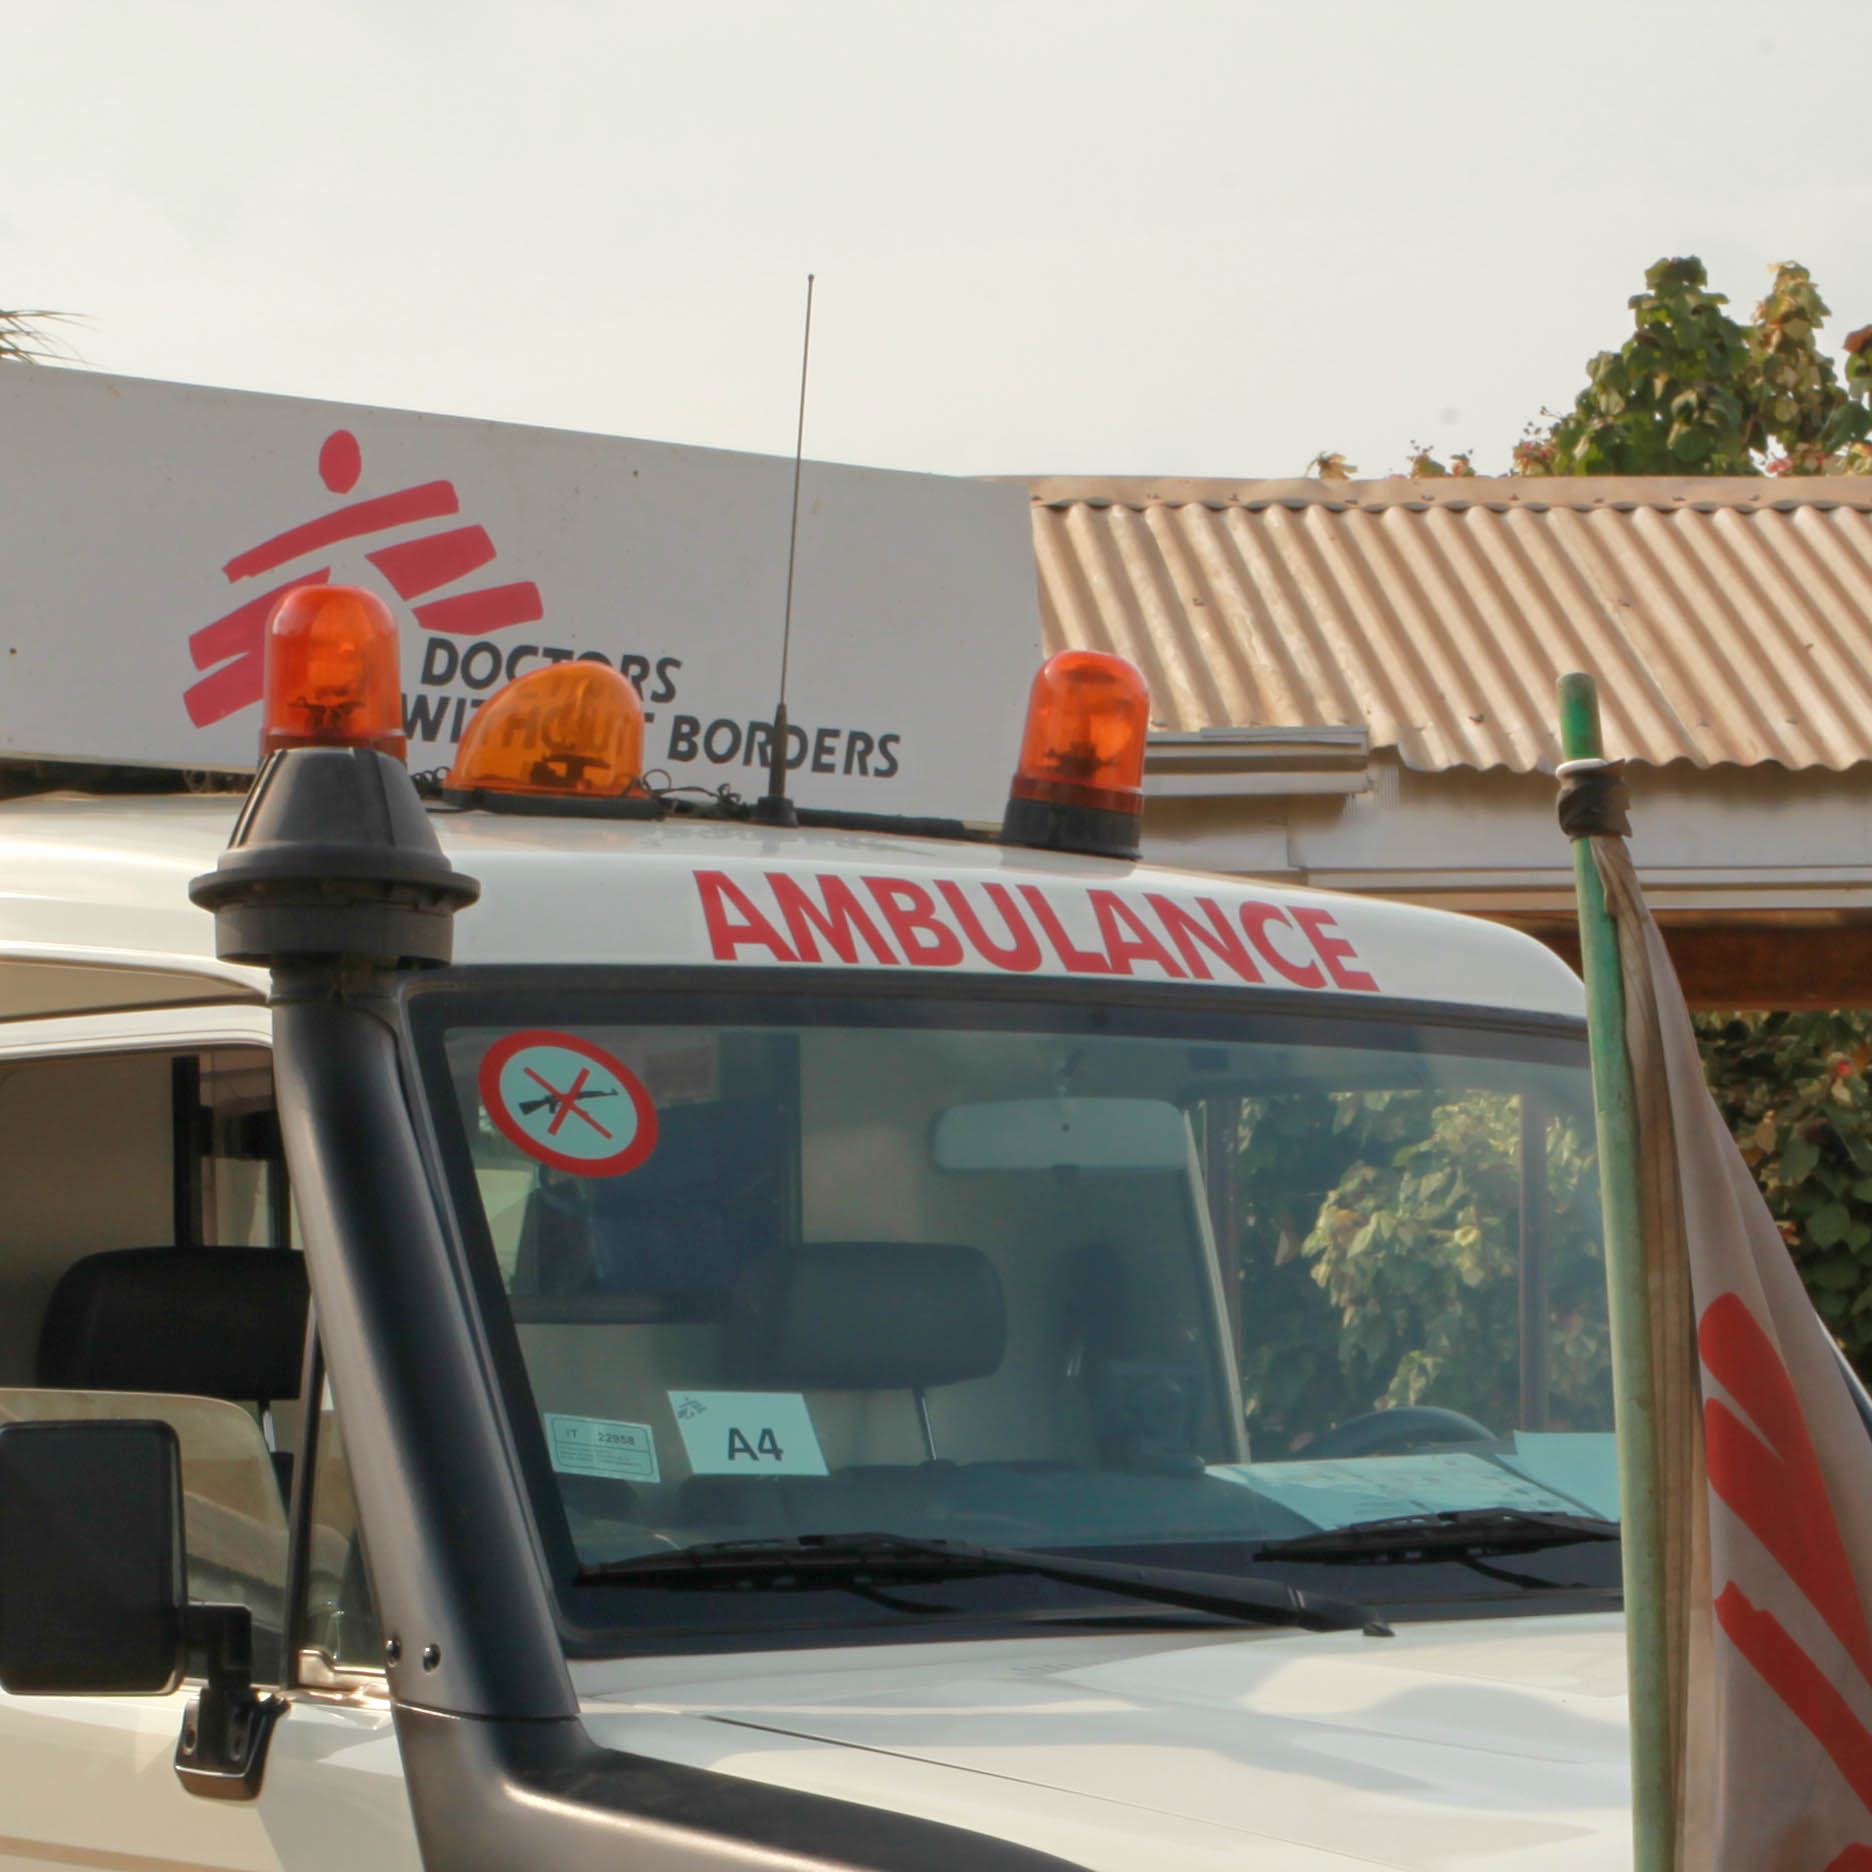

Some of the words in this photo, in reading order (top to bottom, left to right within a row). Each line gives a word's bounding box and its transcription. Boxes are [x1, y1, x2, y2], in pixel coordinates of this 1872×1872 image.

[667, 713, 902, 778] BORDERS
[692, 869, 1381, 993] AMBULANCE
[727, 1427, 784, 1462] A4
